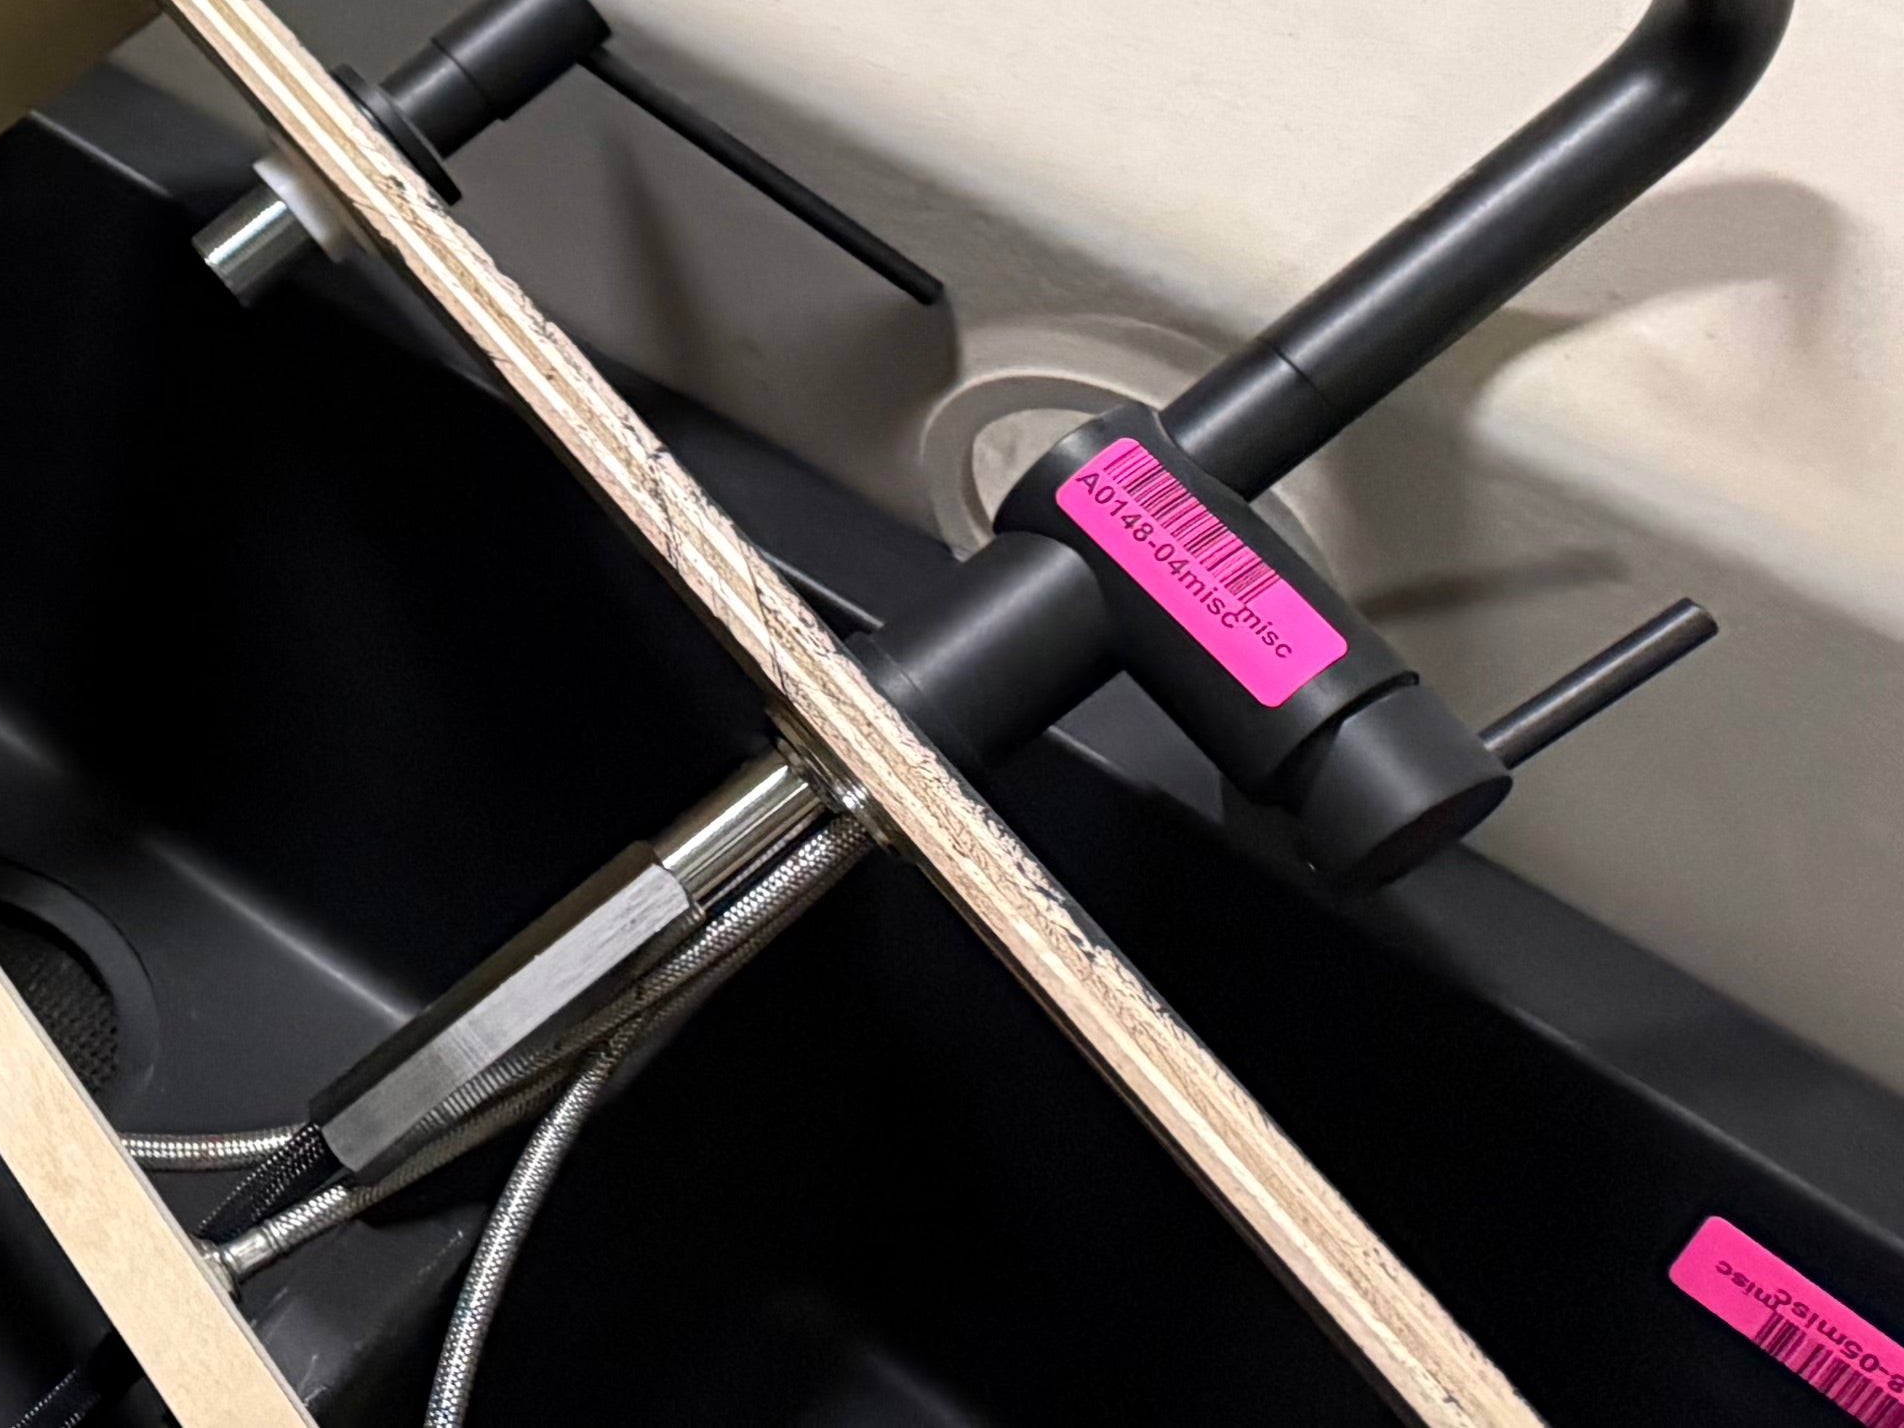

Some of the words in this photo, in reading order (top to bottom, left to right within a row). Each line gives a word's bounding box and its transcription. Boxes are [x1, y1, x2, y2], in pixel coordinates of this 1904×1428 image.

[1075, 471, 1240, 629] A0148-04misc
[1232, 605, 1293, 659] misc
[1715, 1260, 1780, 1313] misc
